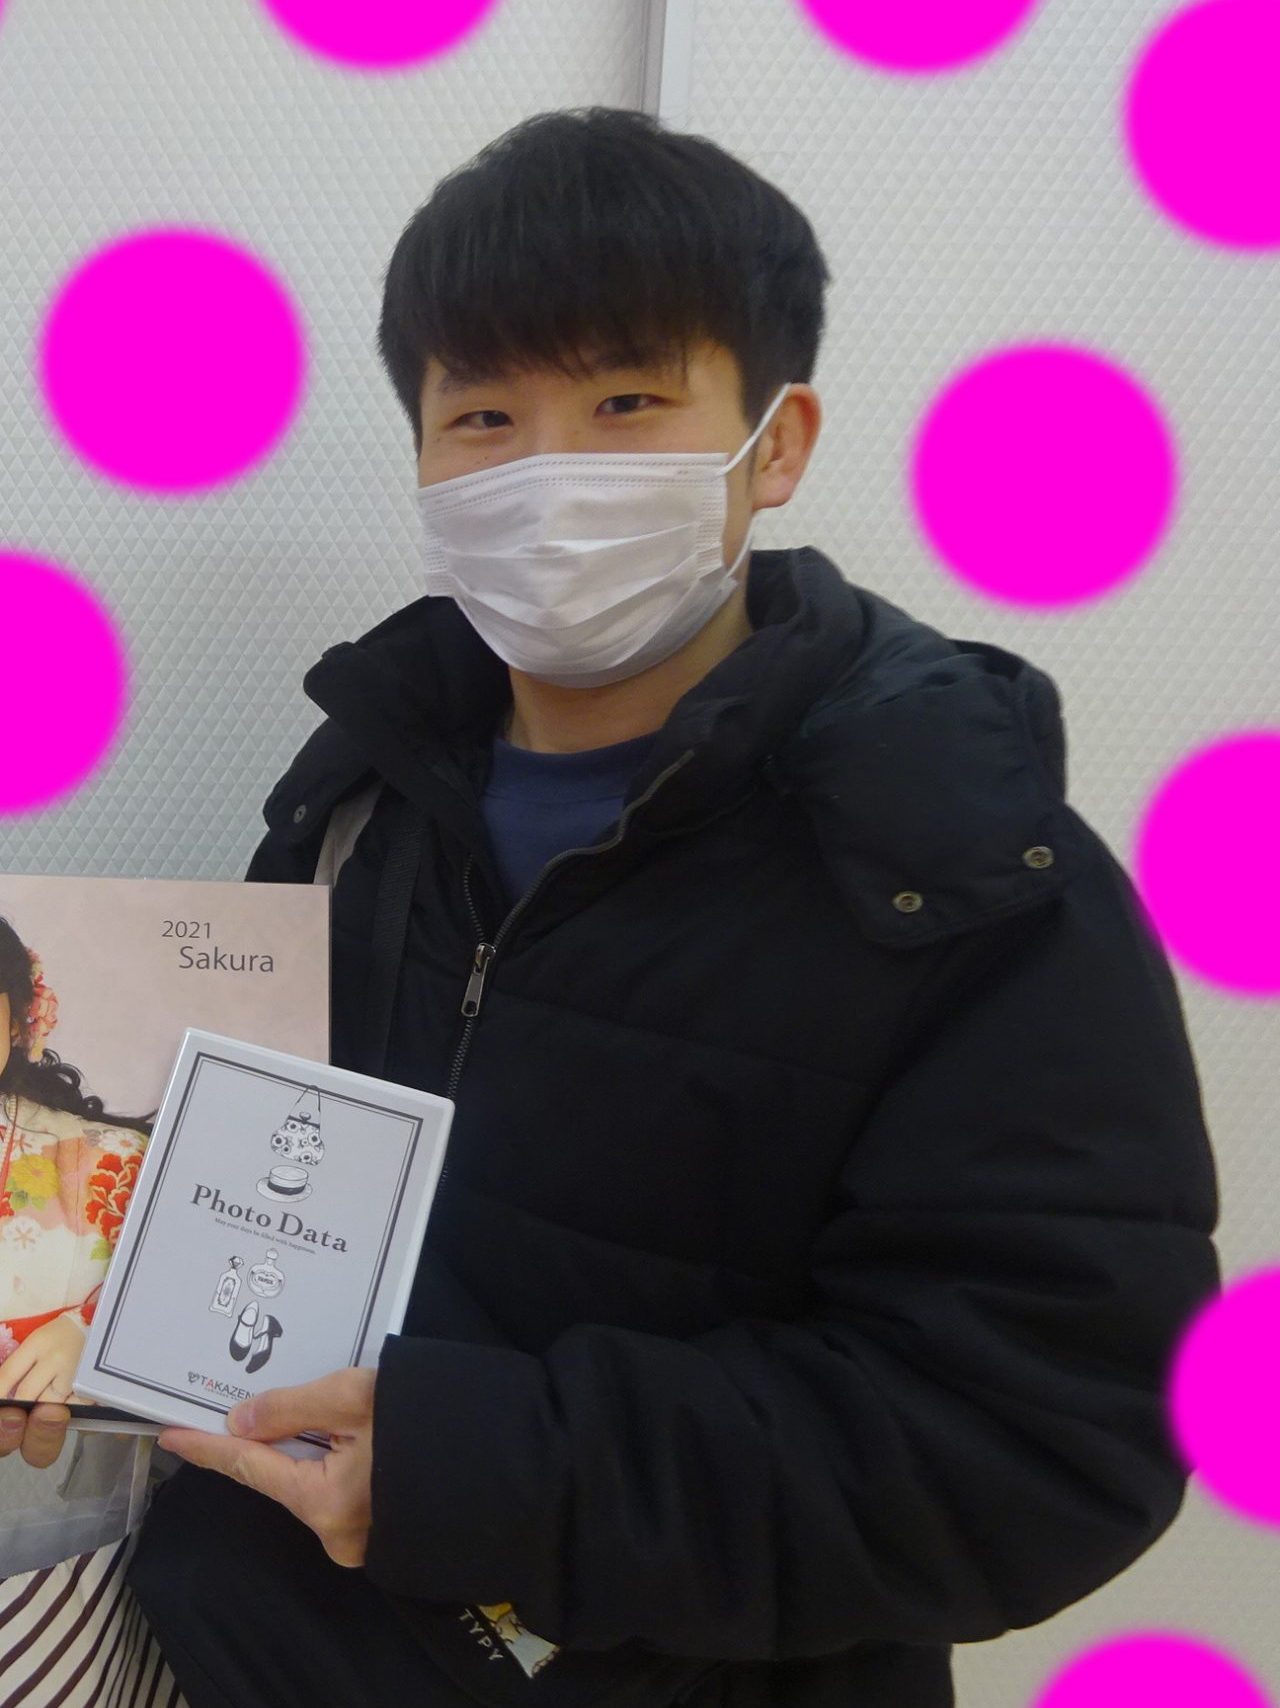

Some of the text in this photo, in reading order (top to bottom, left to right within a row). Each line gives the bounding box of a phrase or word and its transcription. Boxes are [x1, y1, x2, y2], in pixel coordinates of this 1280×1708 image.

[162, 920, 211, 939] 2021
[179, 946, 274, 972] Sakura
[190, 1184, 347, 1252] Photo Data
